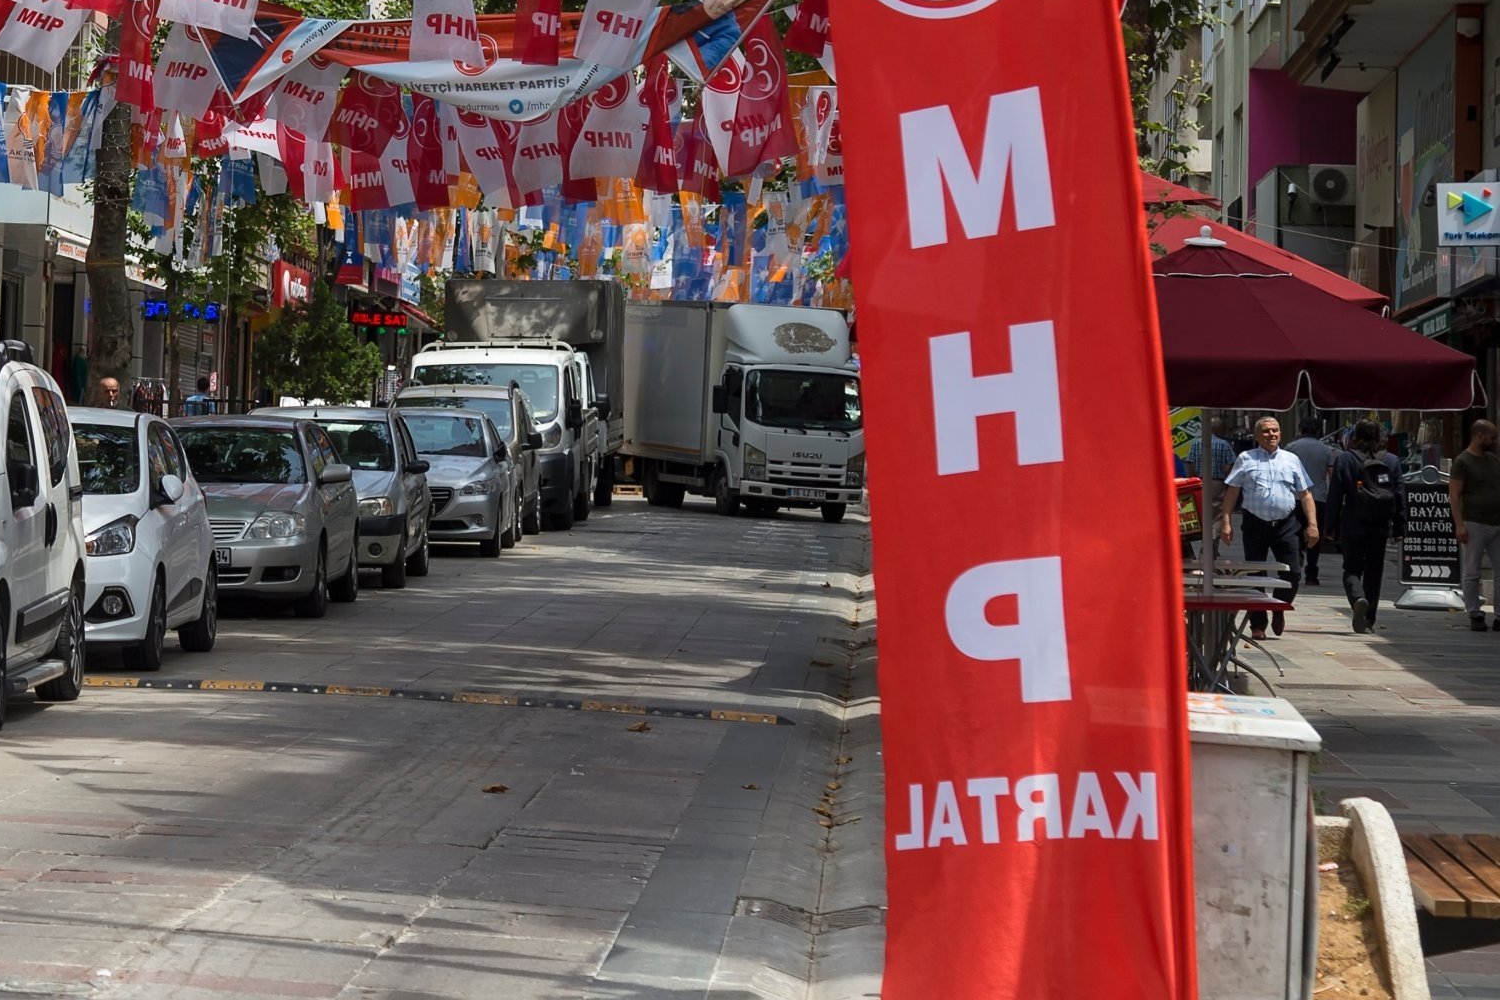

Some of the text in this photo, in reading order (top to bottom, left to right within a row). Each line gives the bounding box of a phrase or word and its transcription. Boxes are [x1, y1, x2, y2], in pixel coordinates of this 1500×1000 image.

[16, 7, 64, 32] MHP
[165, 61, 208, 81] MHP
[455, 80, 515, 92] HAREKET
[519, 75, 570, 90] PARTİSİ
[284, 80, 325, 105] MHP
[336, 109, 379, 132] MHP
[1444, 231, 1462, 240] Türk
[792, 451, 822, 460] ISUZU
[1408, 492, 1451, 504] PODYUM
[1410, 505, 1450, 518] BAYAN
[1407, 520, 1453, 533] KUAFÖR
